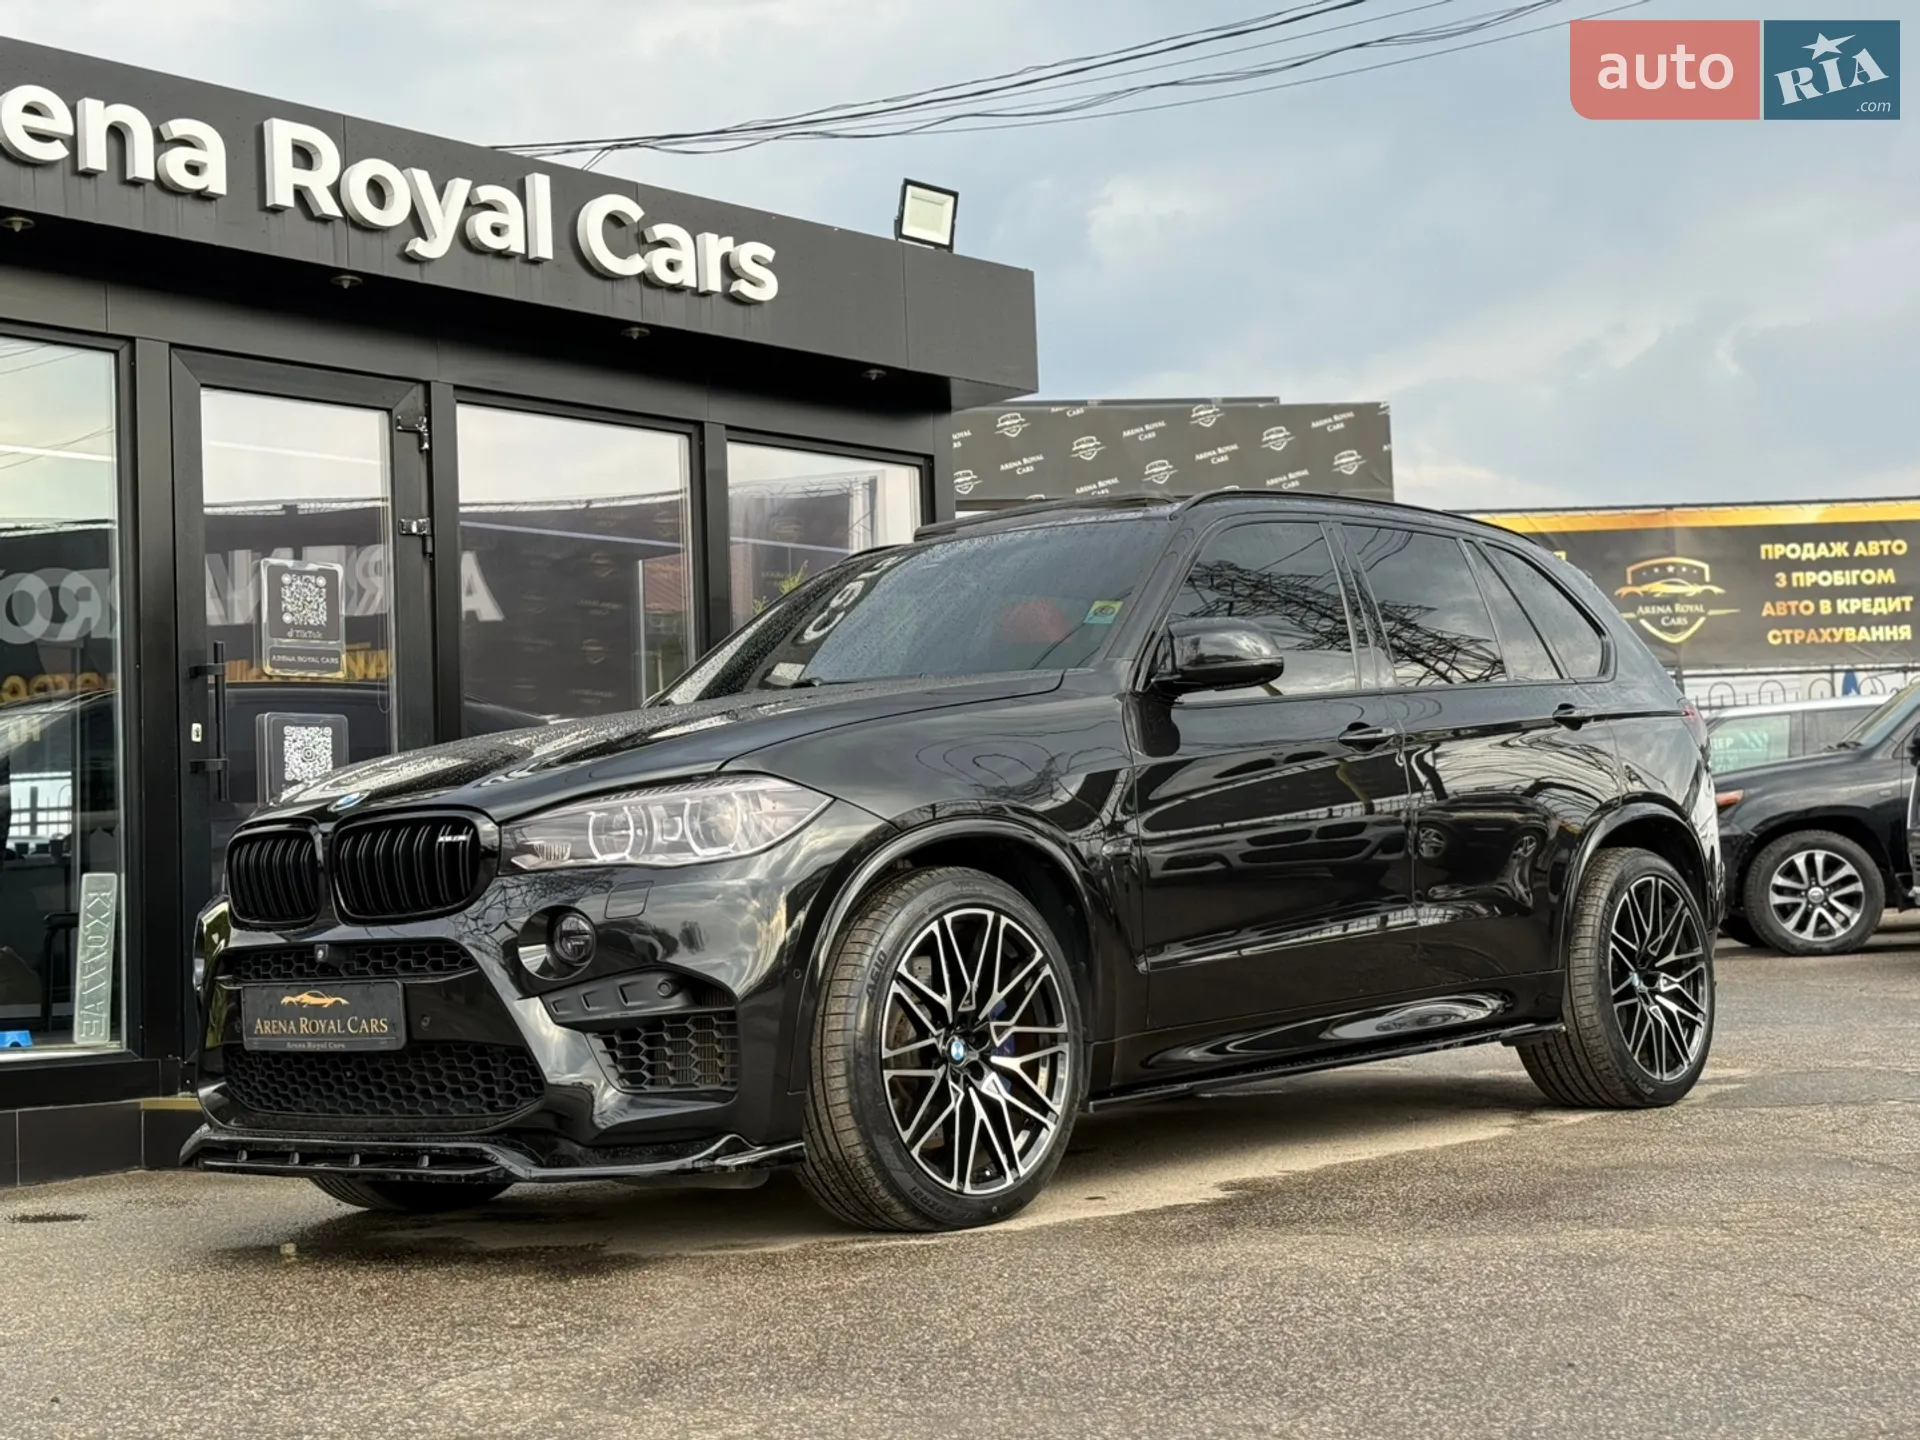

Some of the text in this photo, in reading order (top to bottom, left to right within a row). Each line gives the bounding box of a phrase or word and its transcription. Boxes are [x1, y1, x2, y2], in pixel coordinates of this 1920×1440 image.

[262, 117, 553, 264] Royal
[576, 194, 780, 304] Cars
[1760, 539, 1908, 561] ПРОДАЖ АВТО
[1791, 568, 1896, 587] ПРОБІГОМ
[1674, 603, 1705, 613] ROYAL
[1761, 595, 1914, 617] АВТО В КРЕДИТ
[1660, 616, 1688, 626] CARS
[1767, 624, 1912, 645] СТРАХУВАННЯ
[254, 1016, 389, 1035] ARENA ROYAL CARS
